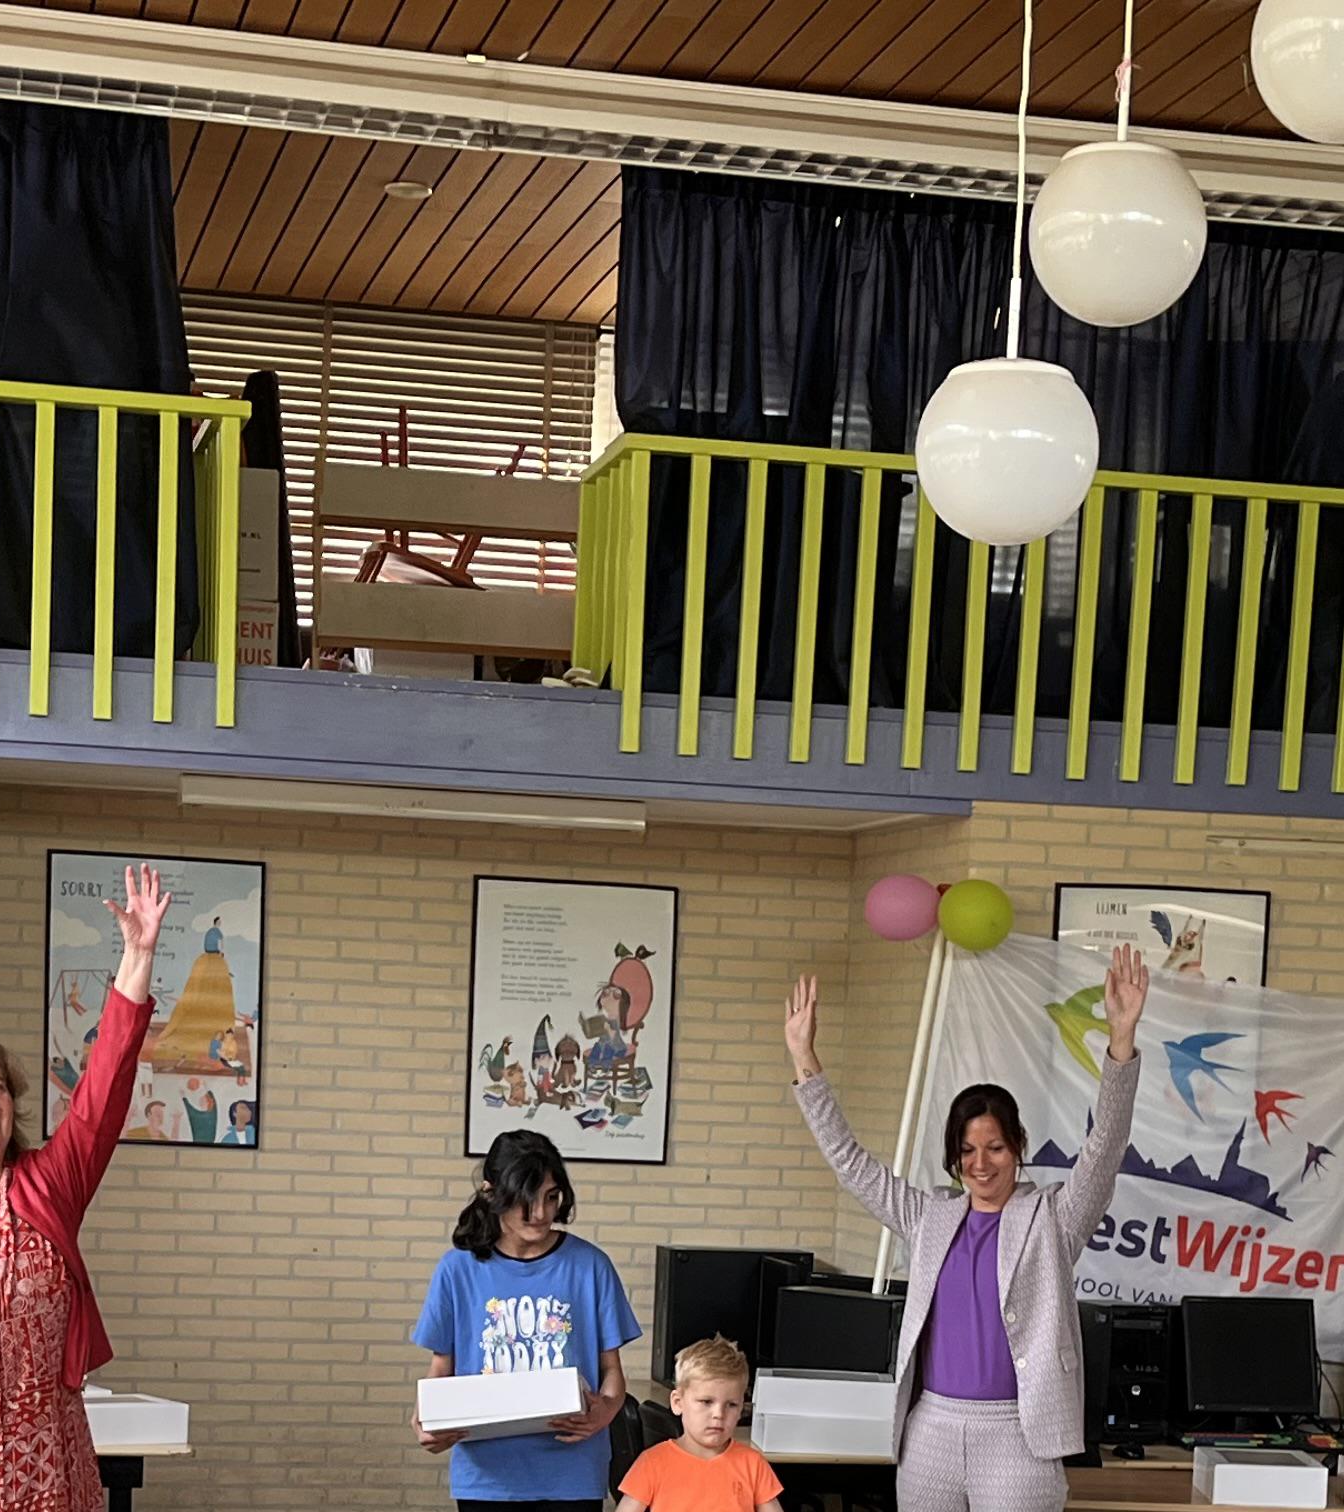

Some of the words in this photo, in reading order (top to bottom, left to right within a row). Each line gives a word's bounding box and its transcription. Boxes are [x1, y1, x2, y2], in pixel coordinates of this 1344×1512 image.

[240, 621, 274, 640] ENT
[60, 881, 104, 898] SORRY
[495, 1295, 551, 1340] NOT
[483, 1337, 567, 1373] TODAY
